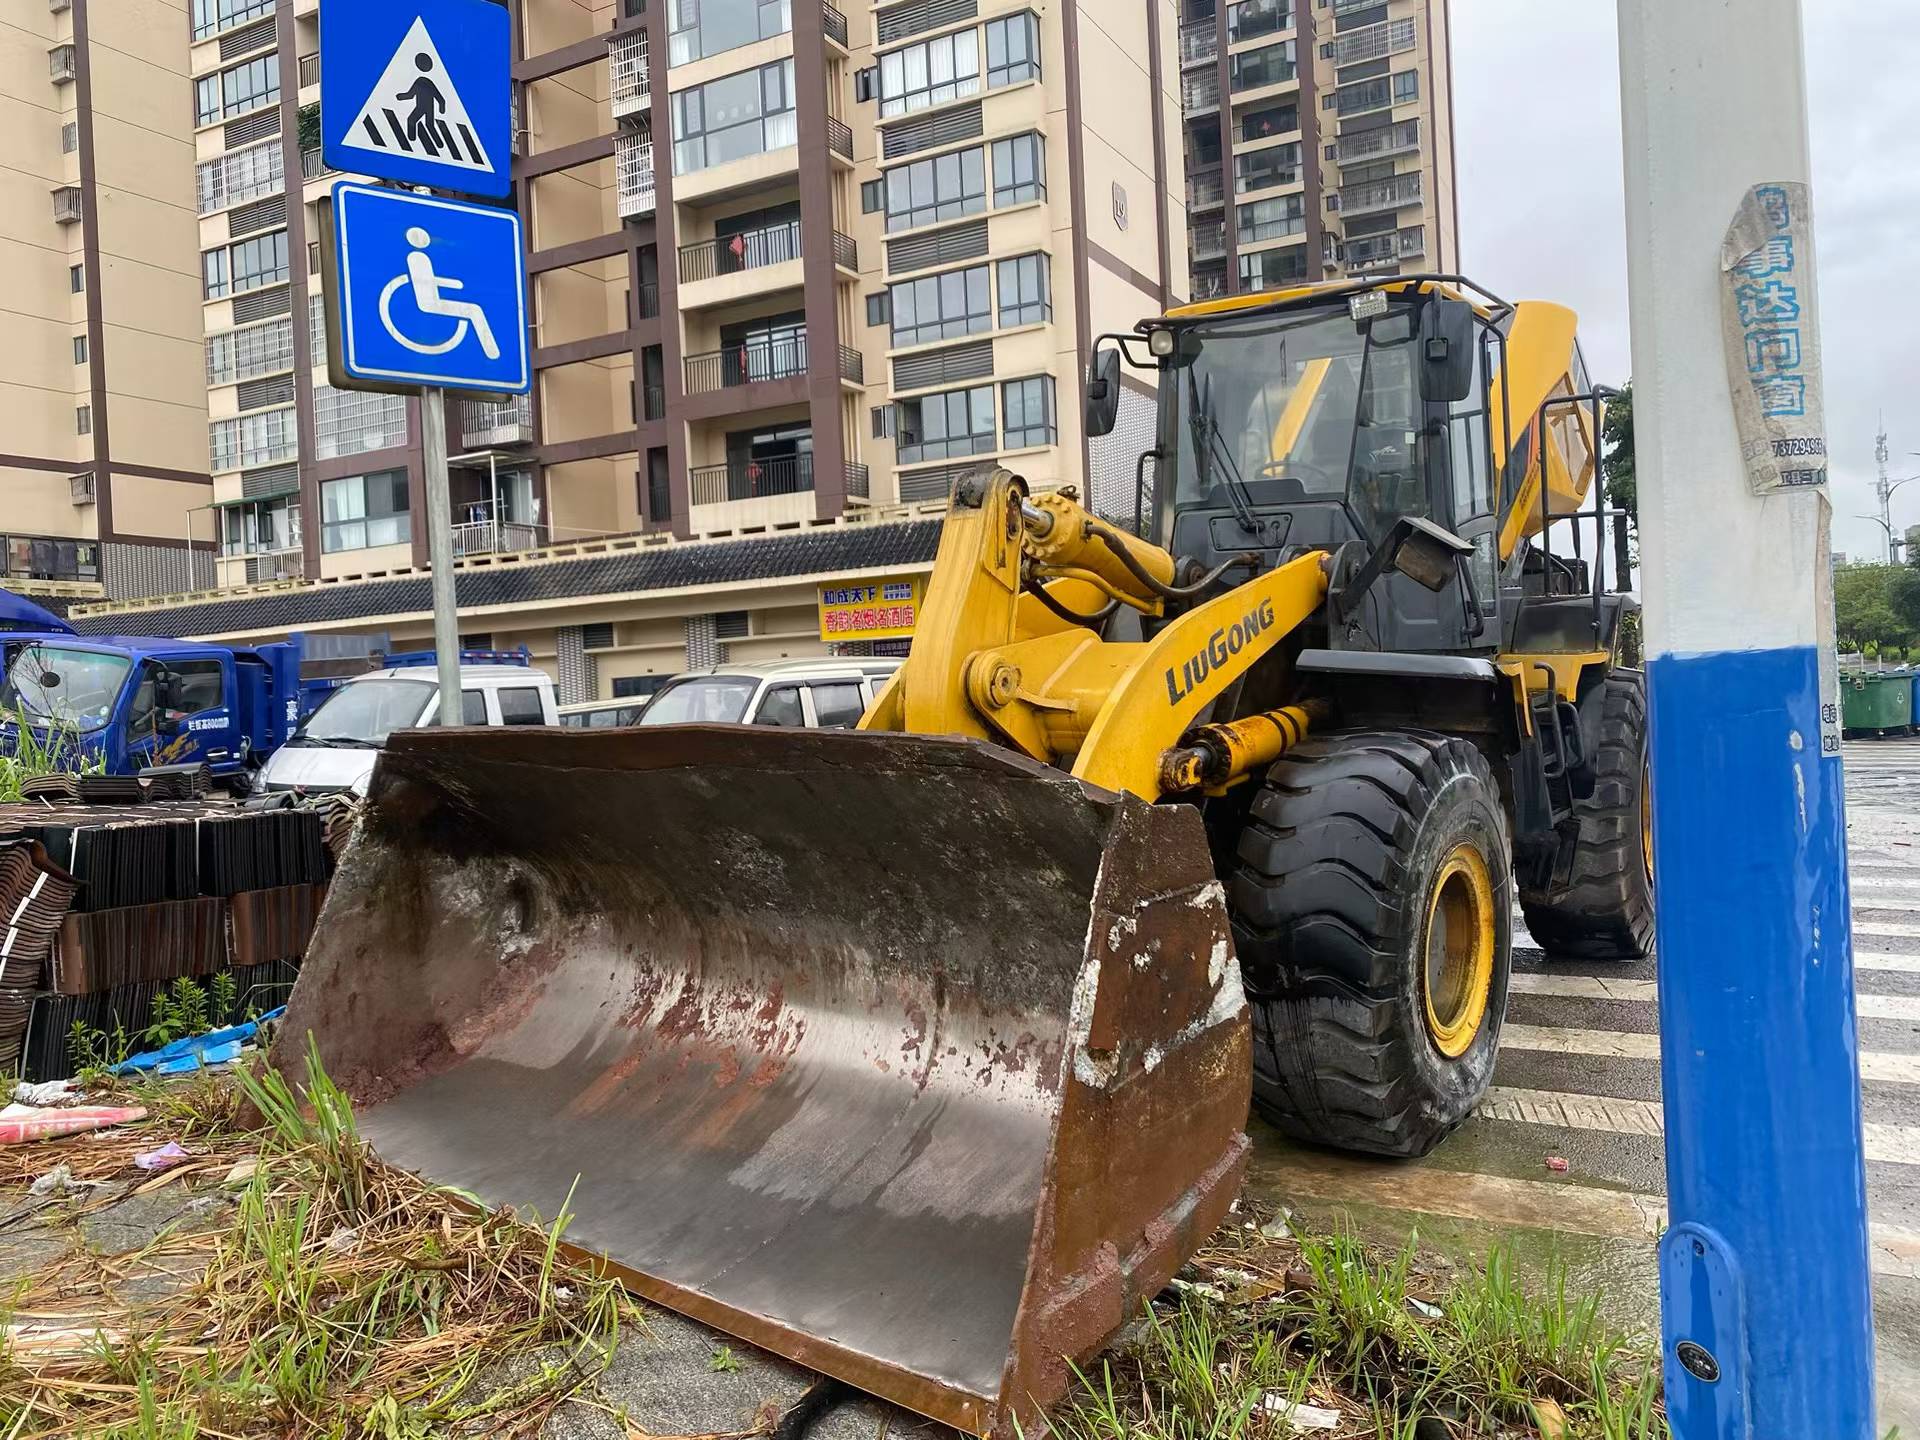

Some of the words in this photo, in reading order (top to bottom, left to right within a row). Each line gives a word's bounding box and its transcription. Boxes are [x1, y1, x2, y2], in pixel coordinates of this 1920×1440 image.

[823, 586, 876, 605] 和成天下
[824, 605, 915, 632] 香韵名烟名酒店
[1165, 596, 1275, 707] LIUGONG
